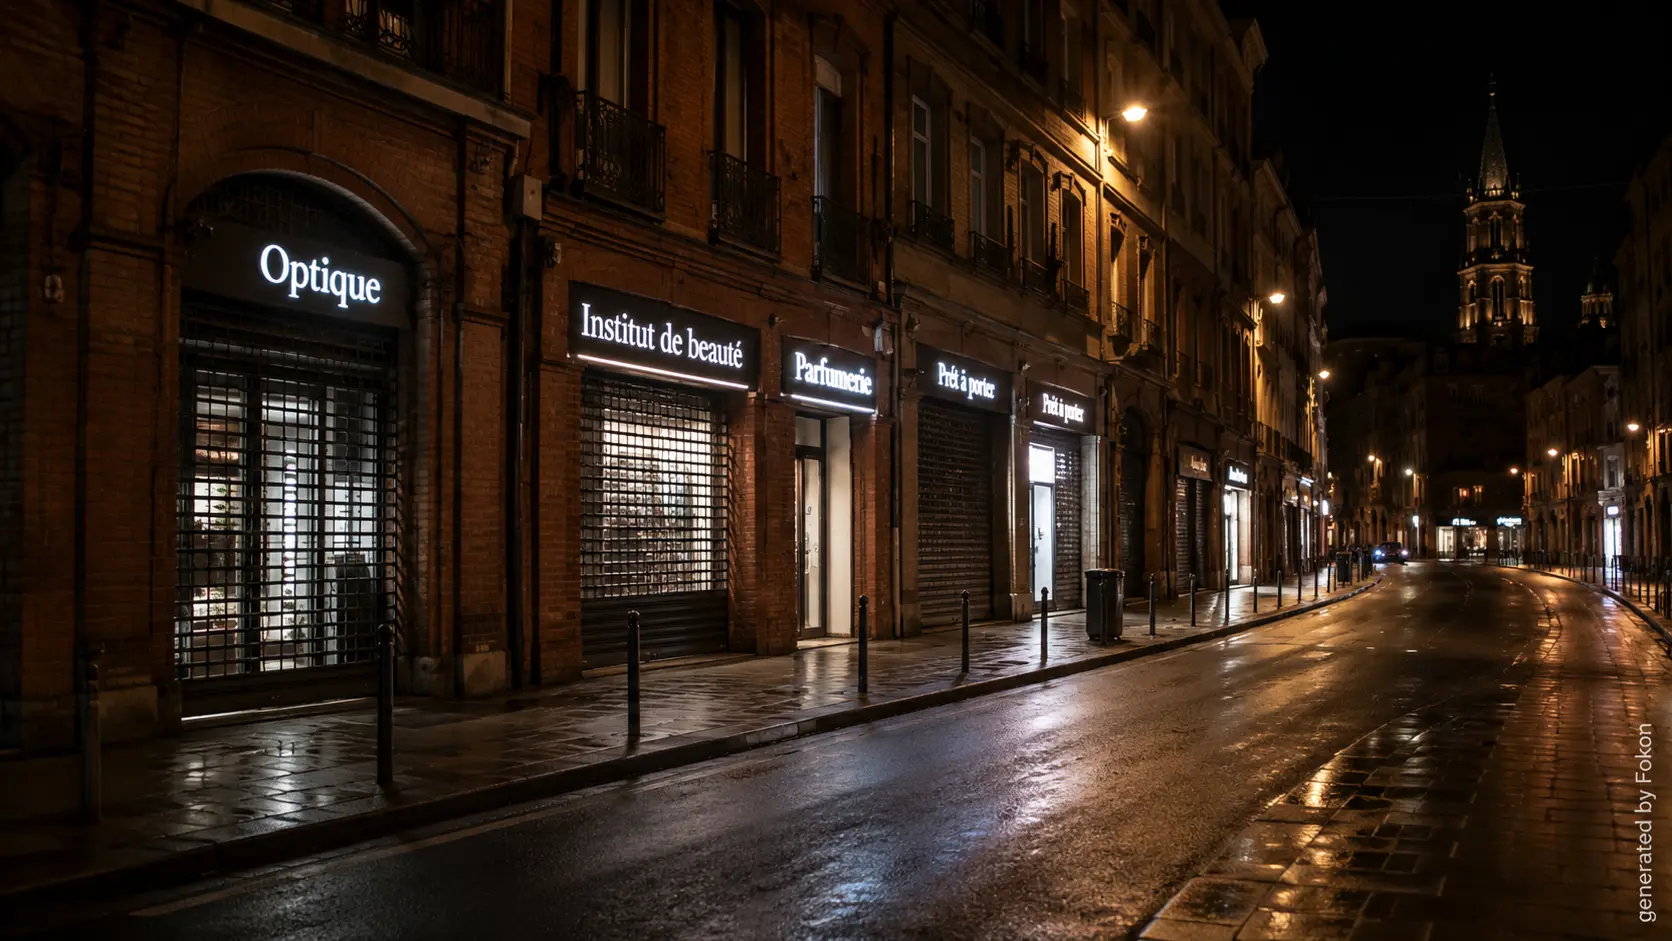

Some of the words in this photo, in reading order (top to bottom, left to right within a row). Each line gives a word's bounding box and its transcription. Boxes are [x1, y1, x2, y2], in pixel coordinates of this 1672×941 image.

[260, 244, 381, 309] Optique
[580, 303, 656, 351] Institut
[660, 322, 683, 355] de
[687, 327, 744, 369] beauté
[794, 351, 873, 395] Parfumerie
[967, 377, 996, 400] porter
